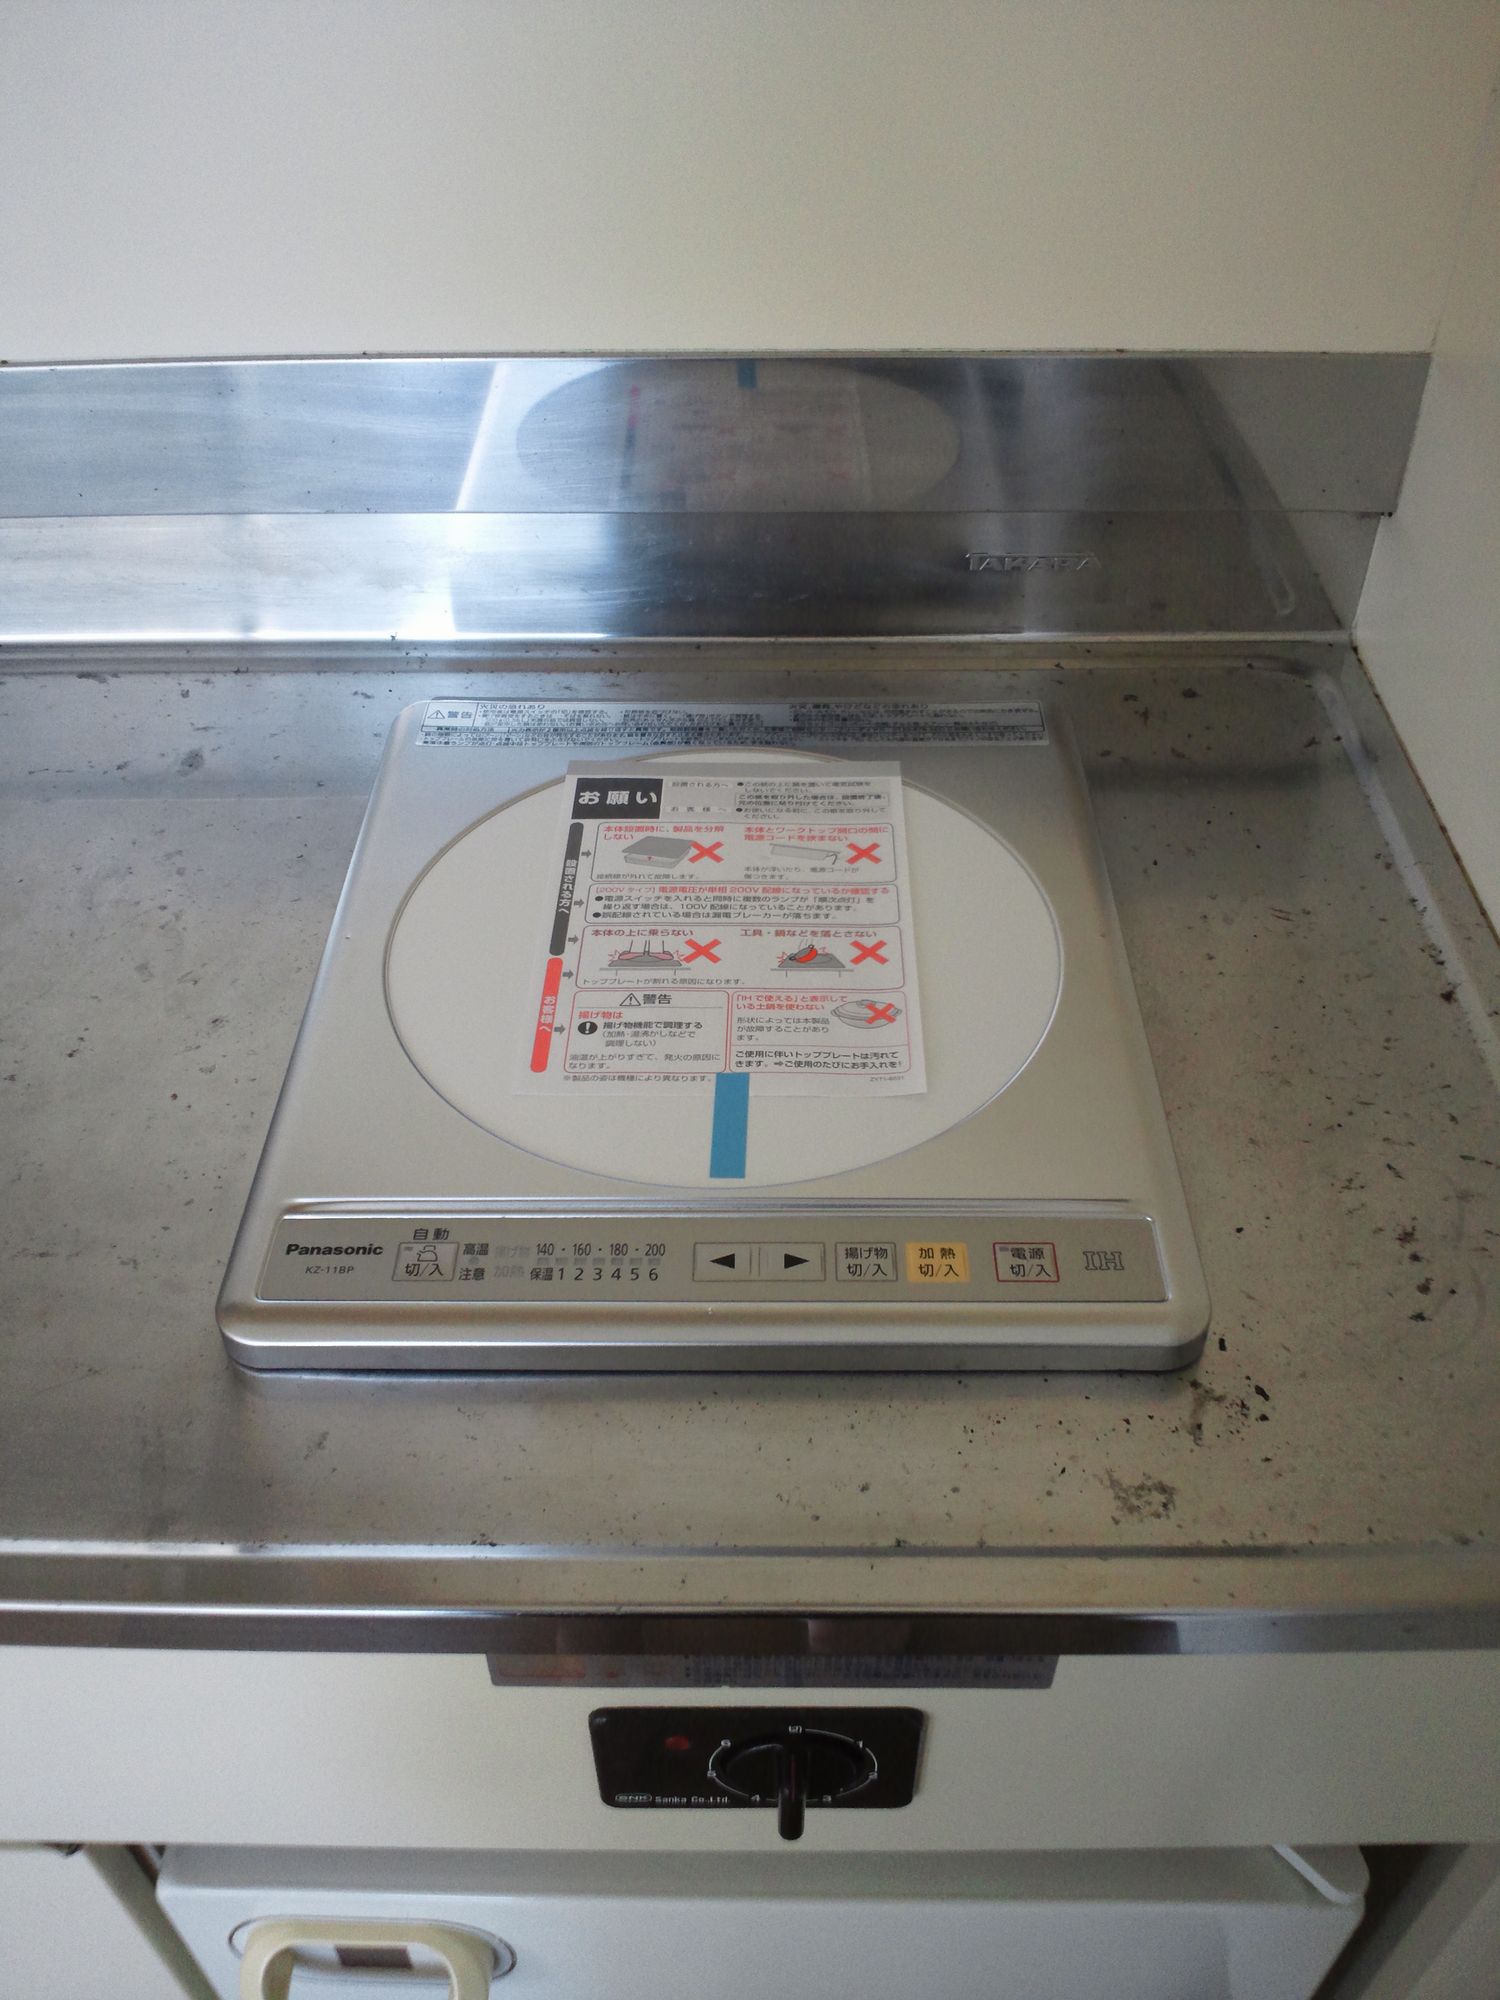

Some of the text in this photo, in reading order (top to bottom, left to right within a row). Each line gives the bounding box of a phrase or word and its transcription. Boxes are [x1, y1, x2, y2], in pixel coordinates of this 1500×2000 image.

[578, 790, 658, 805] お願い
[591, 929, 694, 937] 本体の上に乗らない
[643, 993, 673, 1005] 警告
[578, 1010, 624, 1020] 揚げ物は
[602, 1021, 704, 1030] 揚げ物機能で調理する
[413, 1228, 450, 1241] 自動
[285, 1243, 384, 1256] Panasonic
[462, 1243, 489, 1256] 高温
[535, 1243, 666, 1256] 140 160 180 200
[844, 1246, 889, 1260] 揚げ物
[918, 1246, 957, 1260] 加熱
[1010, 1246, 1046, 1260] 電源
[1082, 1250, 1126, 1271] IH
[305, 1266, 355, 1274] KZ-11BP
[404, 1262, 444, 1277] 切/入
[458, 1266, 486, 1281] 注意
[529, 1267, 660, 1281] 保温 1 2 3 4 5 6
[846, 1263, 888, 1277] 切/入
[917, 1263, 960, 1277] 切/入
[1009, 1263, 1050, 1278] 切/入
[655, 1795, 688, 1804] Sanka
